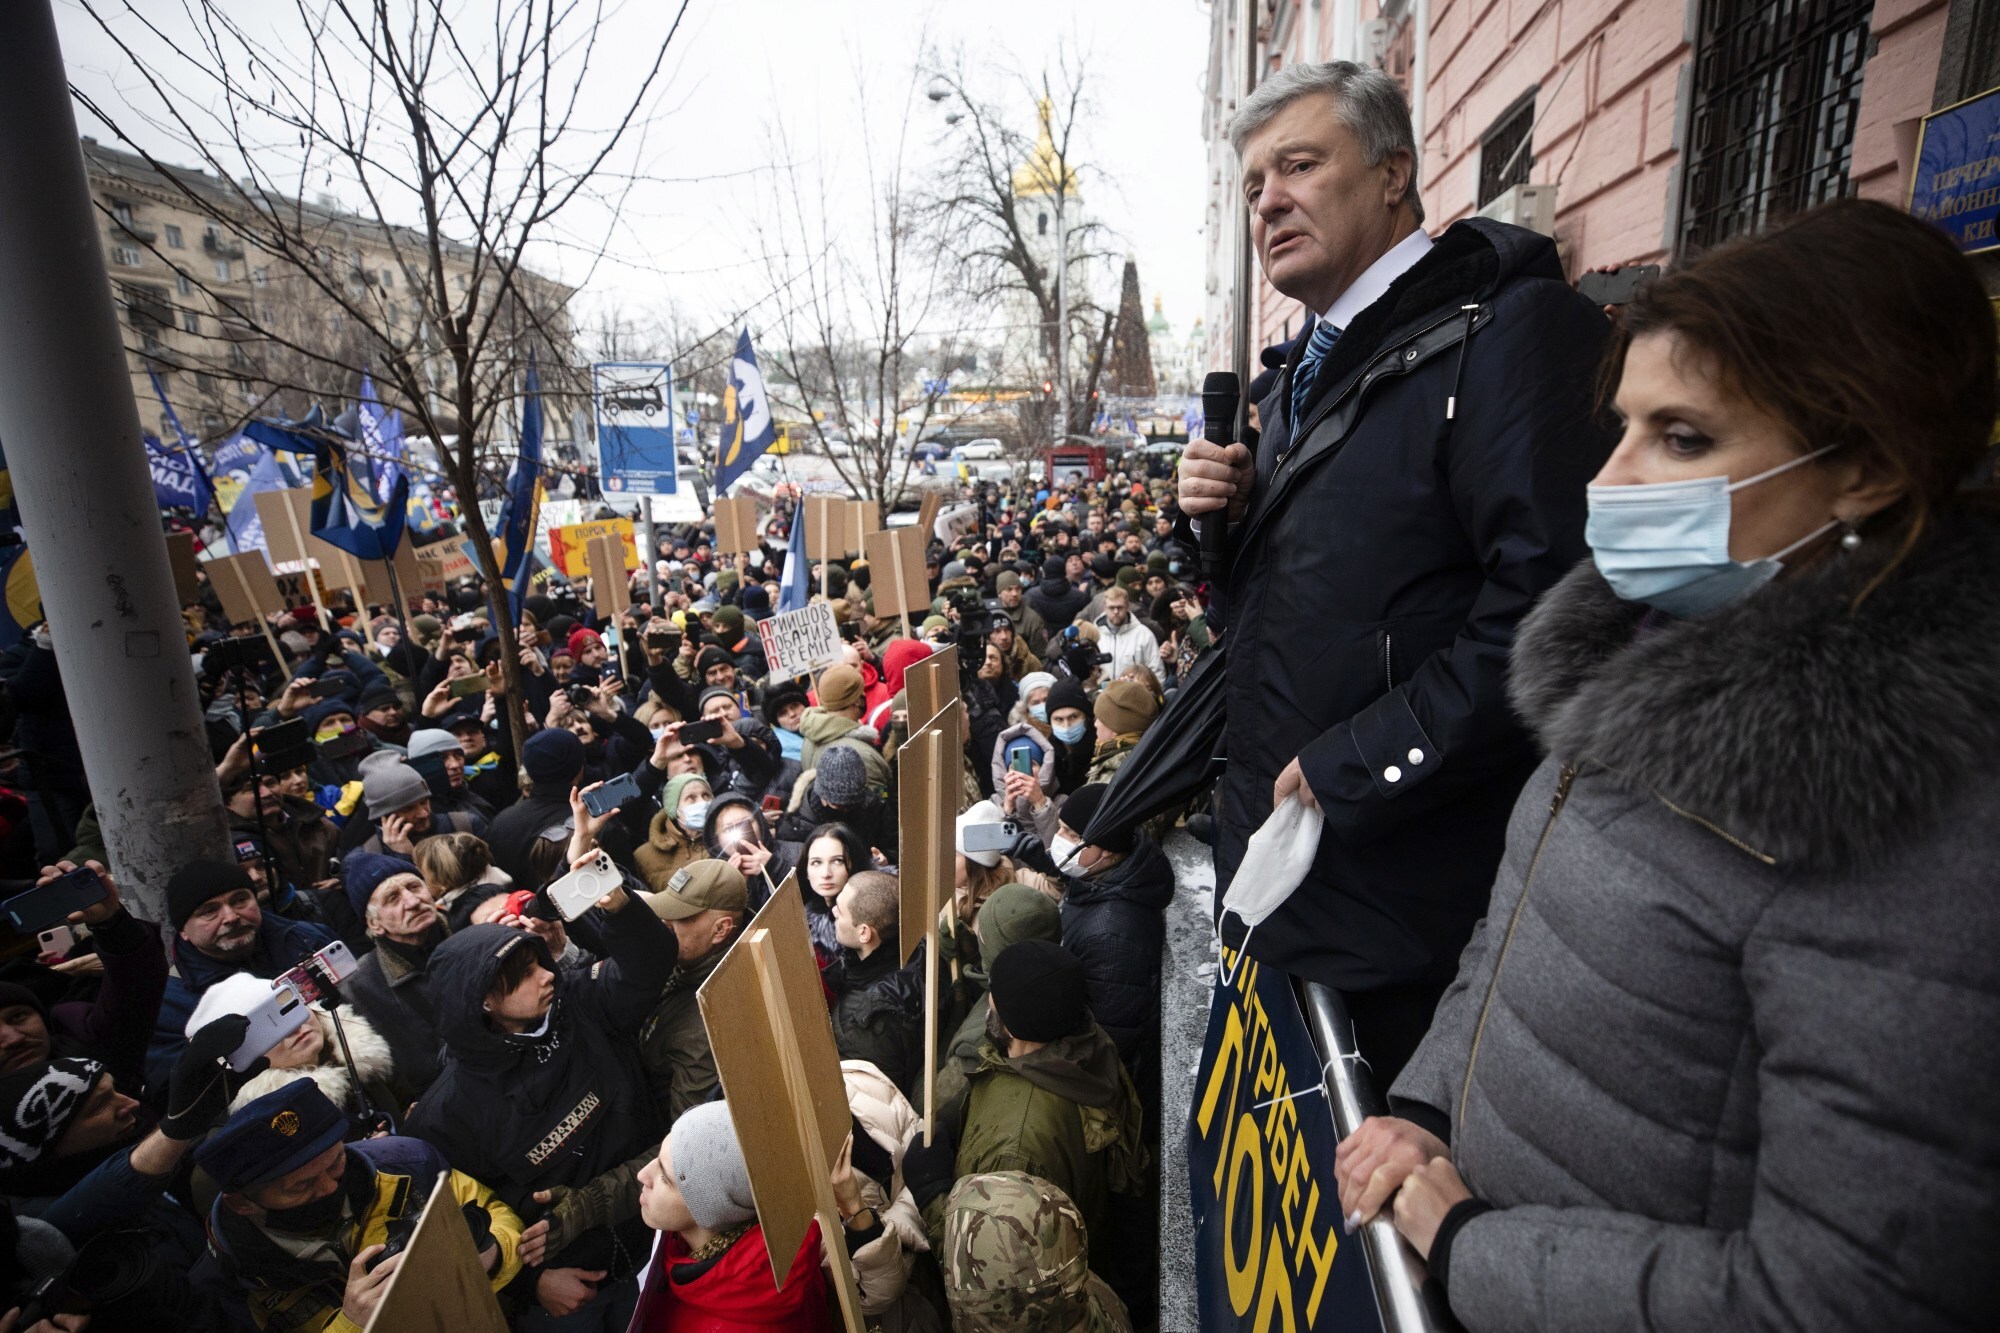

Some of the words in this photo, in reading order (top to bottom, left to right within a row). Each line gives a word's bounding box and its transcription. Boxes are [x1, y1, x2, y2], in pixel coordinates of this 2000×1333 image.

[1963, 218, 1999, 243] КИ
[575, 525, 606, 540] ПОРОХ
[763, 621, 832, 657] ПОБАЧИВ
[768, 637, 831, 672] ПЕРЕМІГ
[526, 1092, 600, 1165] NAPAPIJRI
